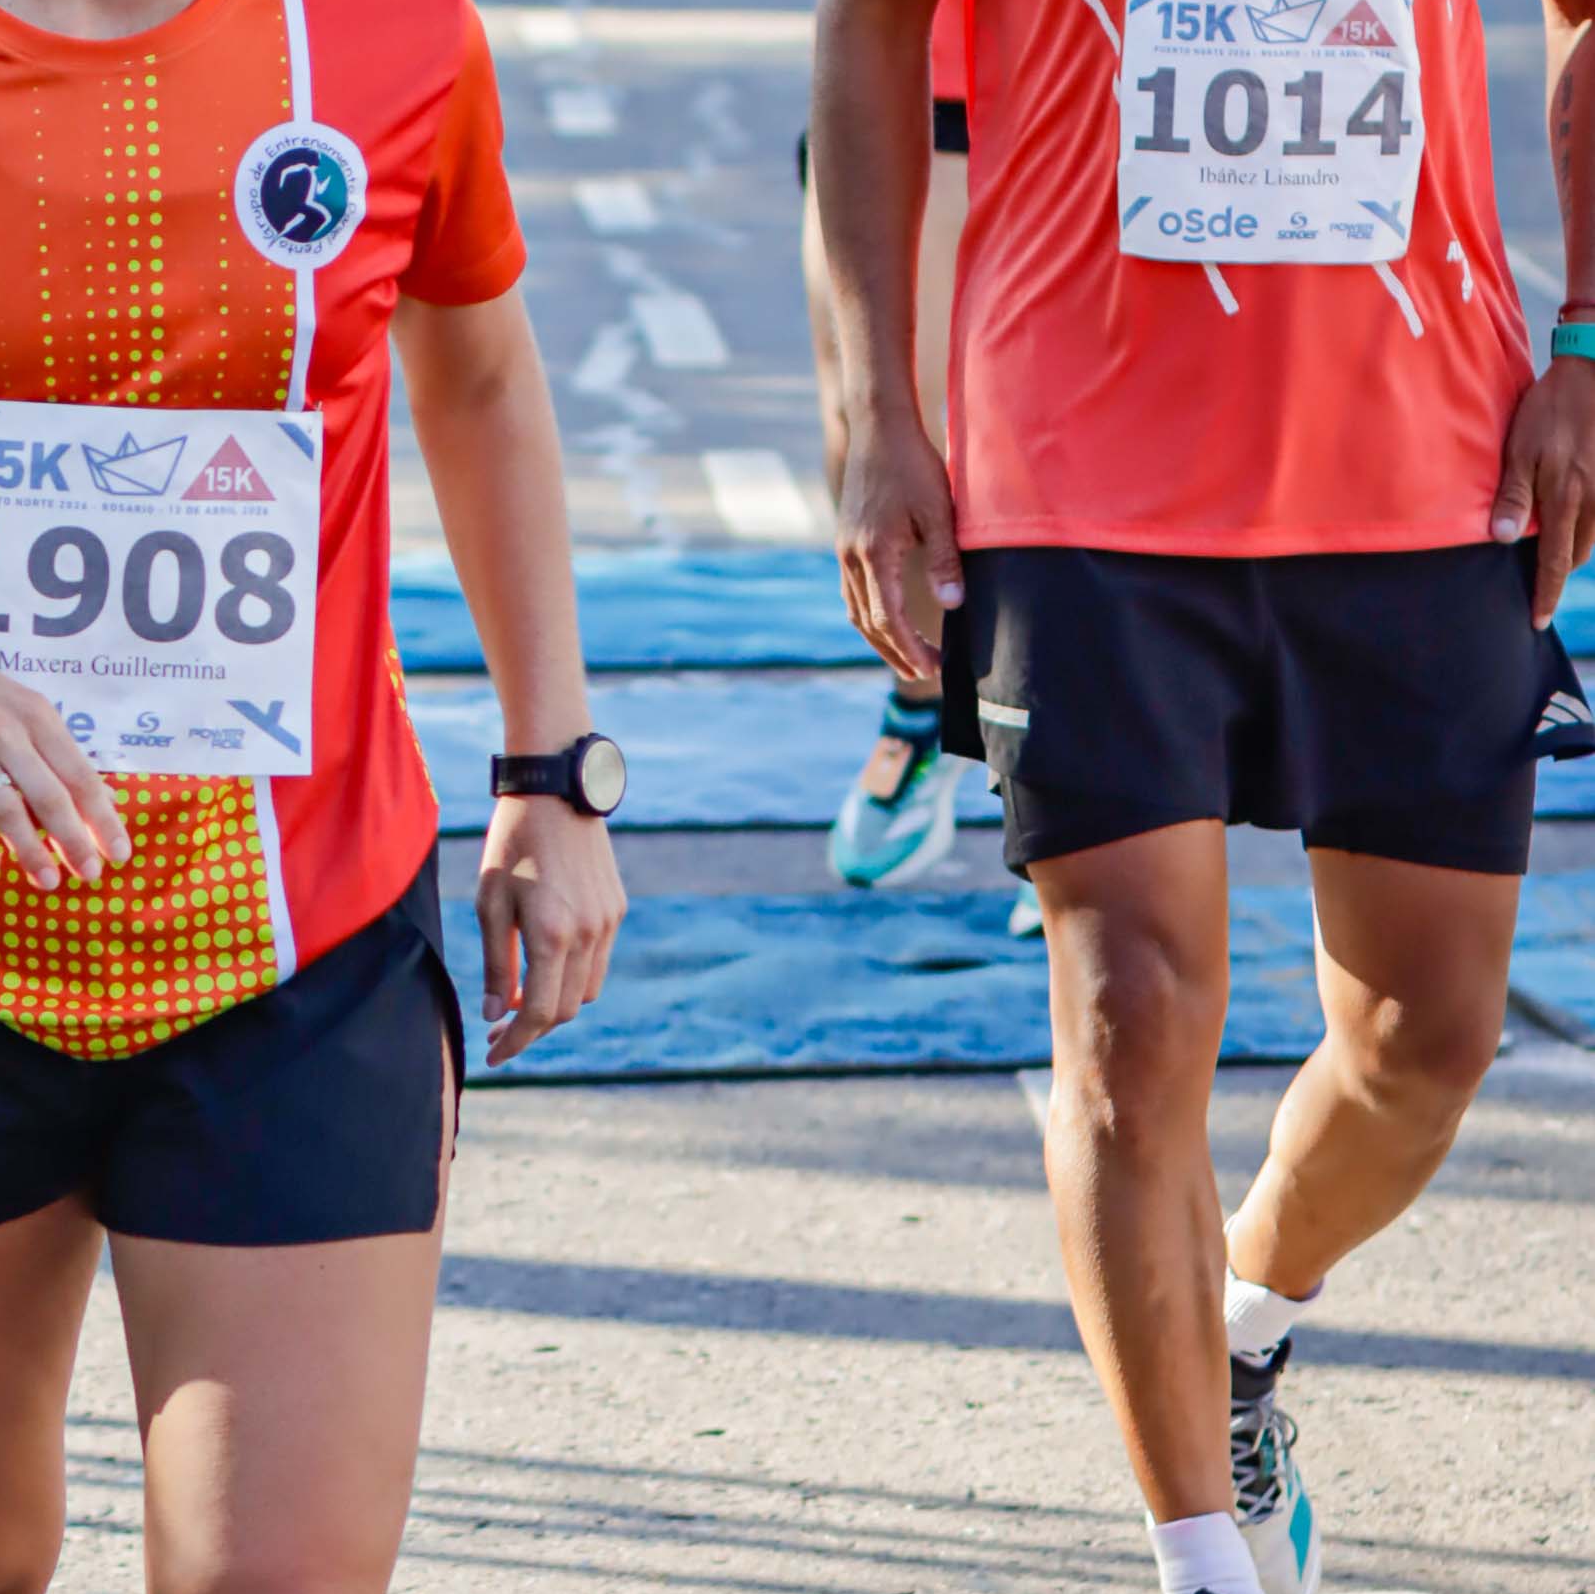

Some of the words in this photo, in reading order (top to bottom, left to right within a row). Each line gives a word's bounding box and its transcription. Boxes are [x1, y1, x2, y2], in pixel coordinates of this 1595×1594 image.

[1157, 1, 1237, 42] 15K
[1340, 20, 1380, 40] 15K
[1134, 66, 1412, 156] 1014
[1199, 165, 1258, 185] Ibáñez
[1264, 167, 1340, 186] Lisandro
[1158, 206, 1259, 241] osde
[204, 466, 255, 492] 15K
[15, 497, 54, 508] NORTE
[91, 654, 227, 680] Guillermina
